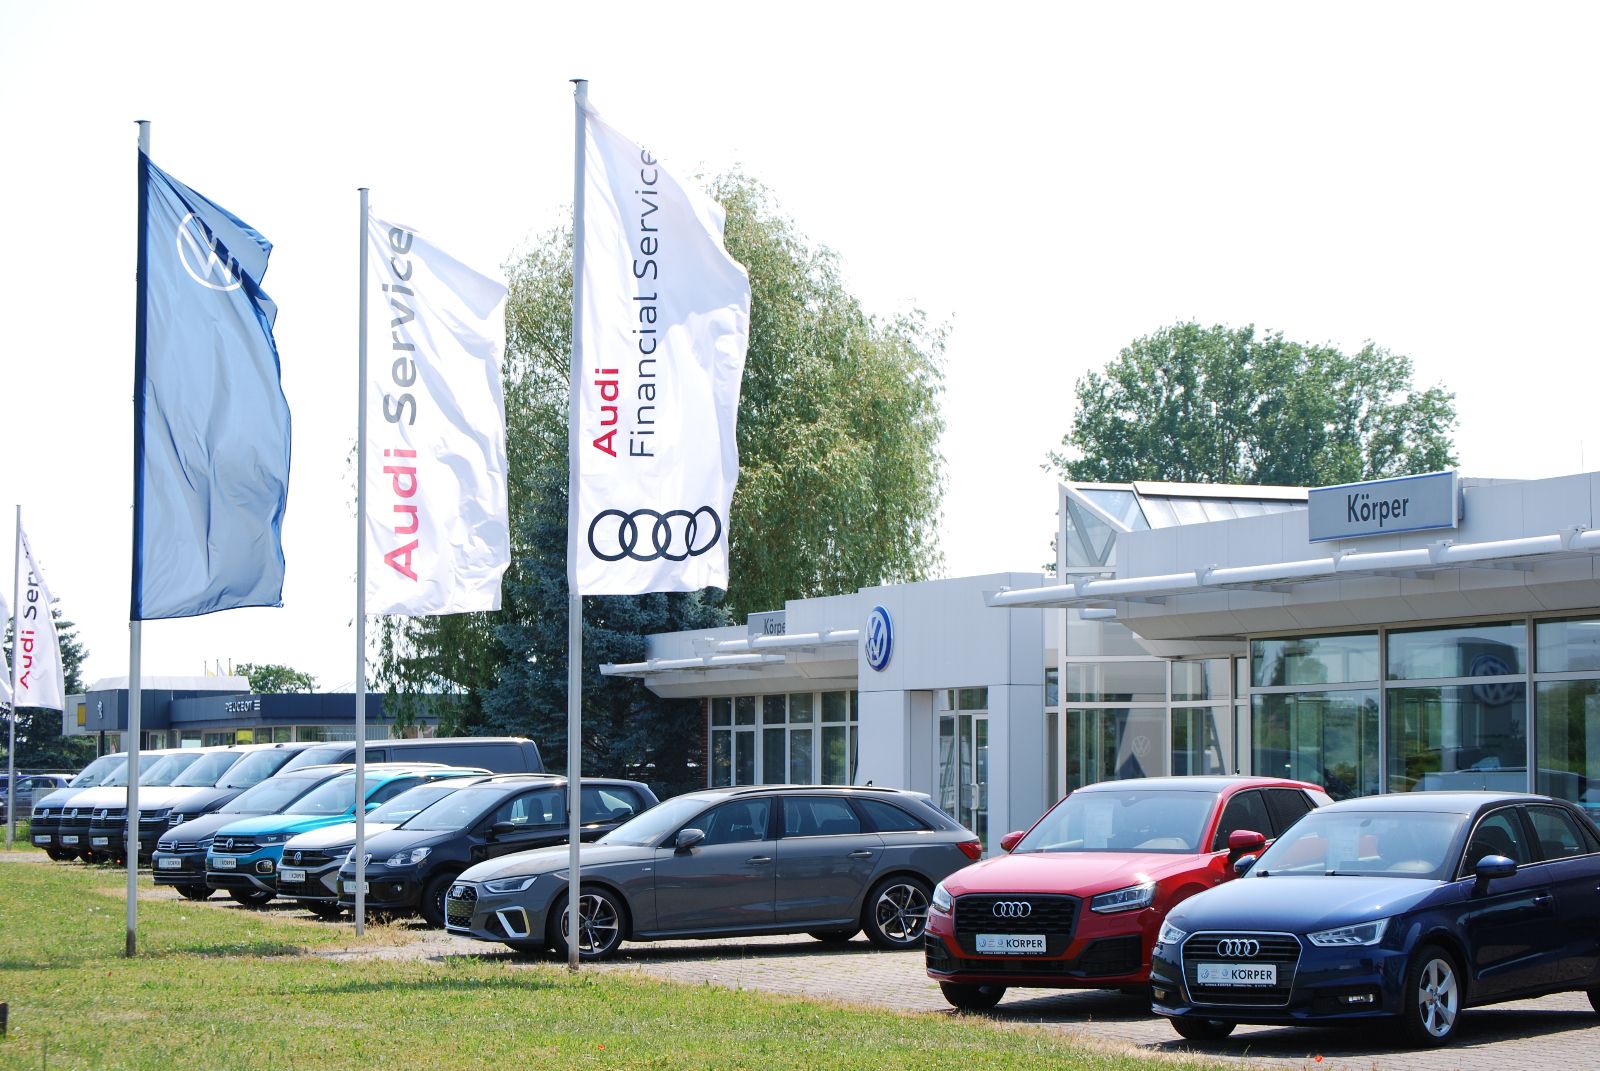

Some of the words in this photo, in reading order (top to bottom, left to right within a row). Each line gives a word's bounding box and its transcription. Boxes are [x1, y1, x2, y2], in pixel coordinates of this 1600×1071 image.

[382, 226, 417, 426] Service
[630, 292, 658, 457] Financial
[593, 368, 619, 458] Audi
[383, 448, 418, 582] Audi
[1347, 493, 1409, 528] Körper
[764, 618, 786, 636] Körpe
[20, 630, 35, 690] Audi
[1006, 938, 1043, 948] KÖRPER
[1231, 968, 1273, 980] KÖRPER
